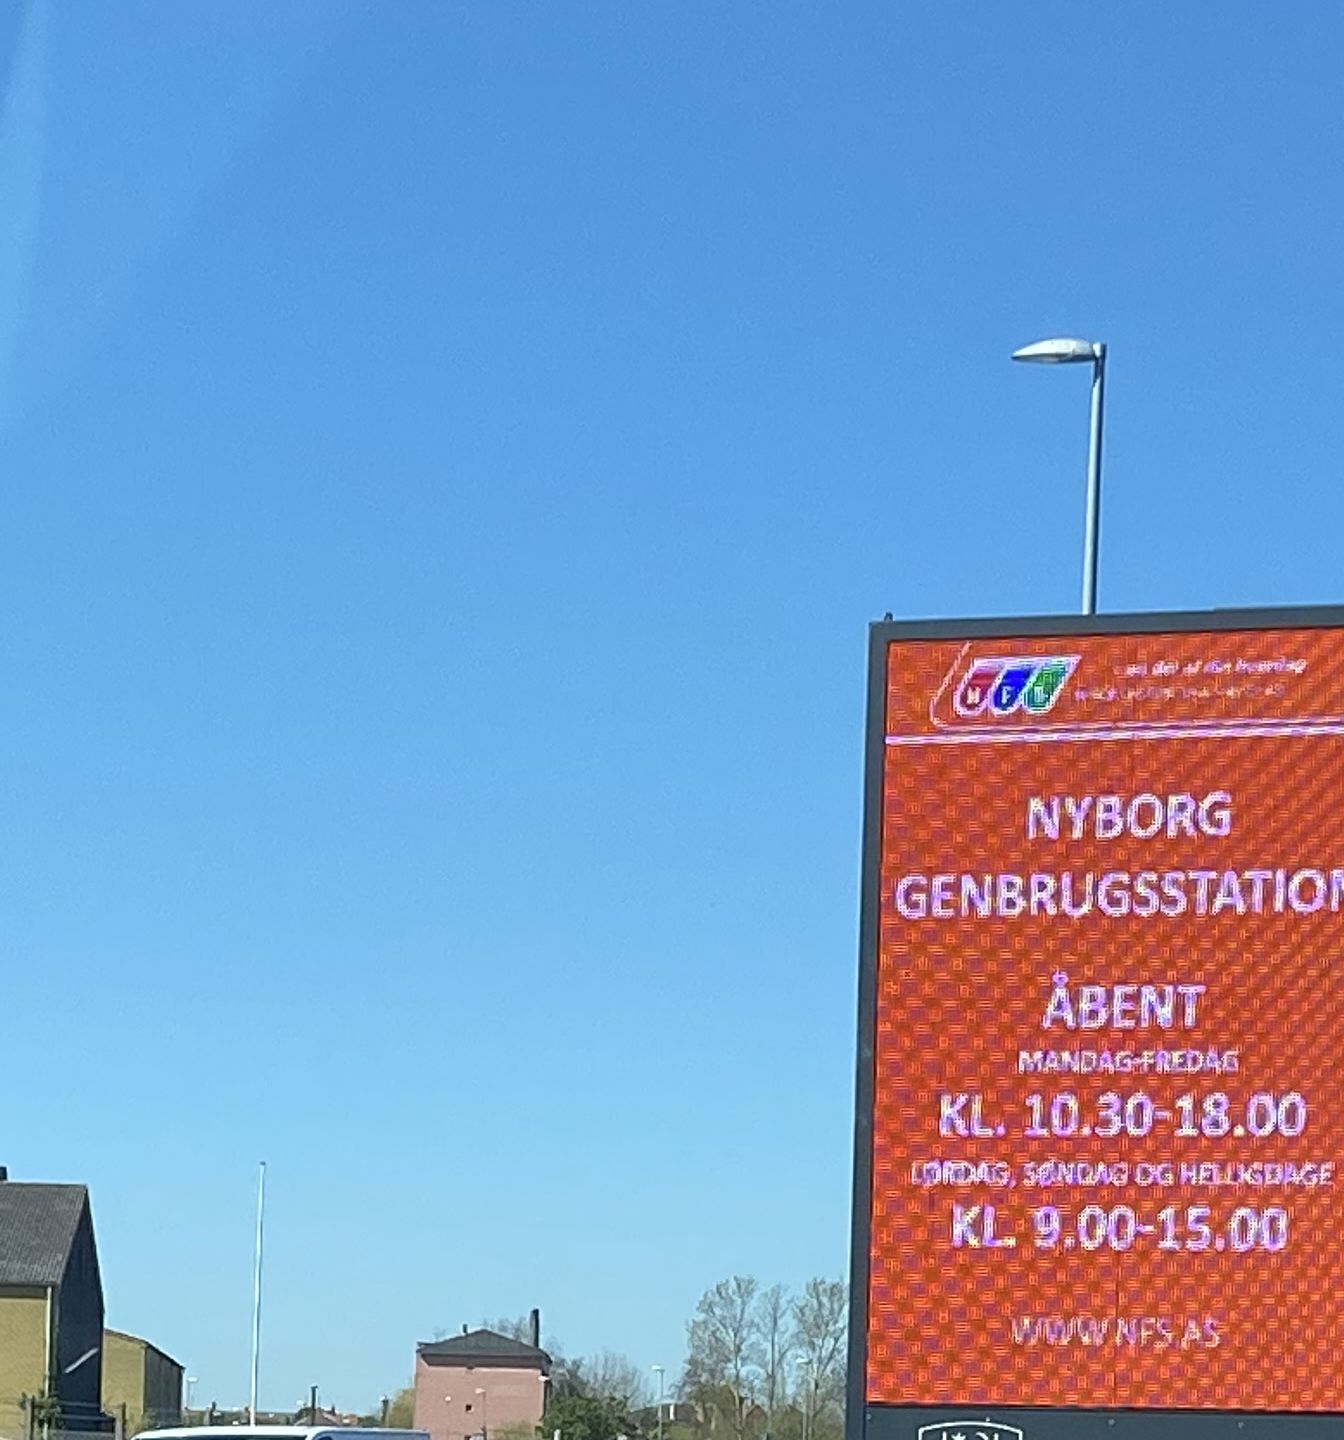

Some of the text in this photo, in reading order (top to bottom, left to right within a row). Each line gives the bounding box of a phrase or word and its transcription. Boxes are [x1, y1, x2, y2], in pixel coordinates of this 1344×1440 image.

[1027, 792, 1232, 839] NYBORG
[1042, 970, 1205, 1029] ÅBENT
[939, 1093, 1307, 1137] KL. 10.30-18.00
[1136, 1162, 1174, 1187] OG
[953, 1205, 1288, 1251] KL. 9.00-15.00
